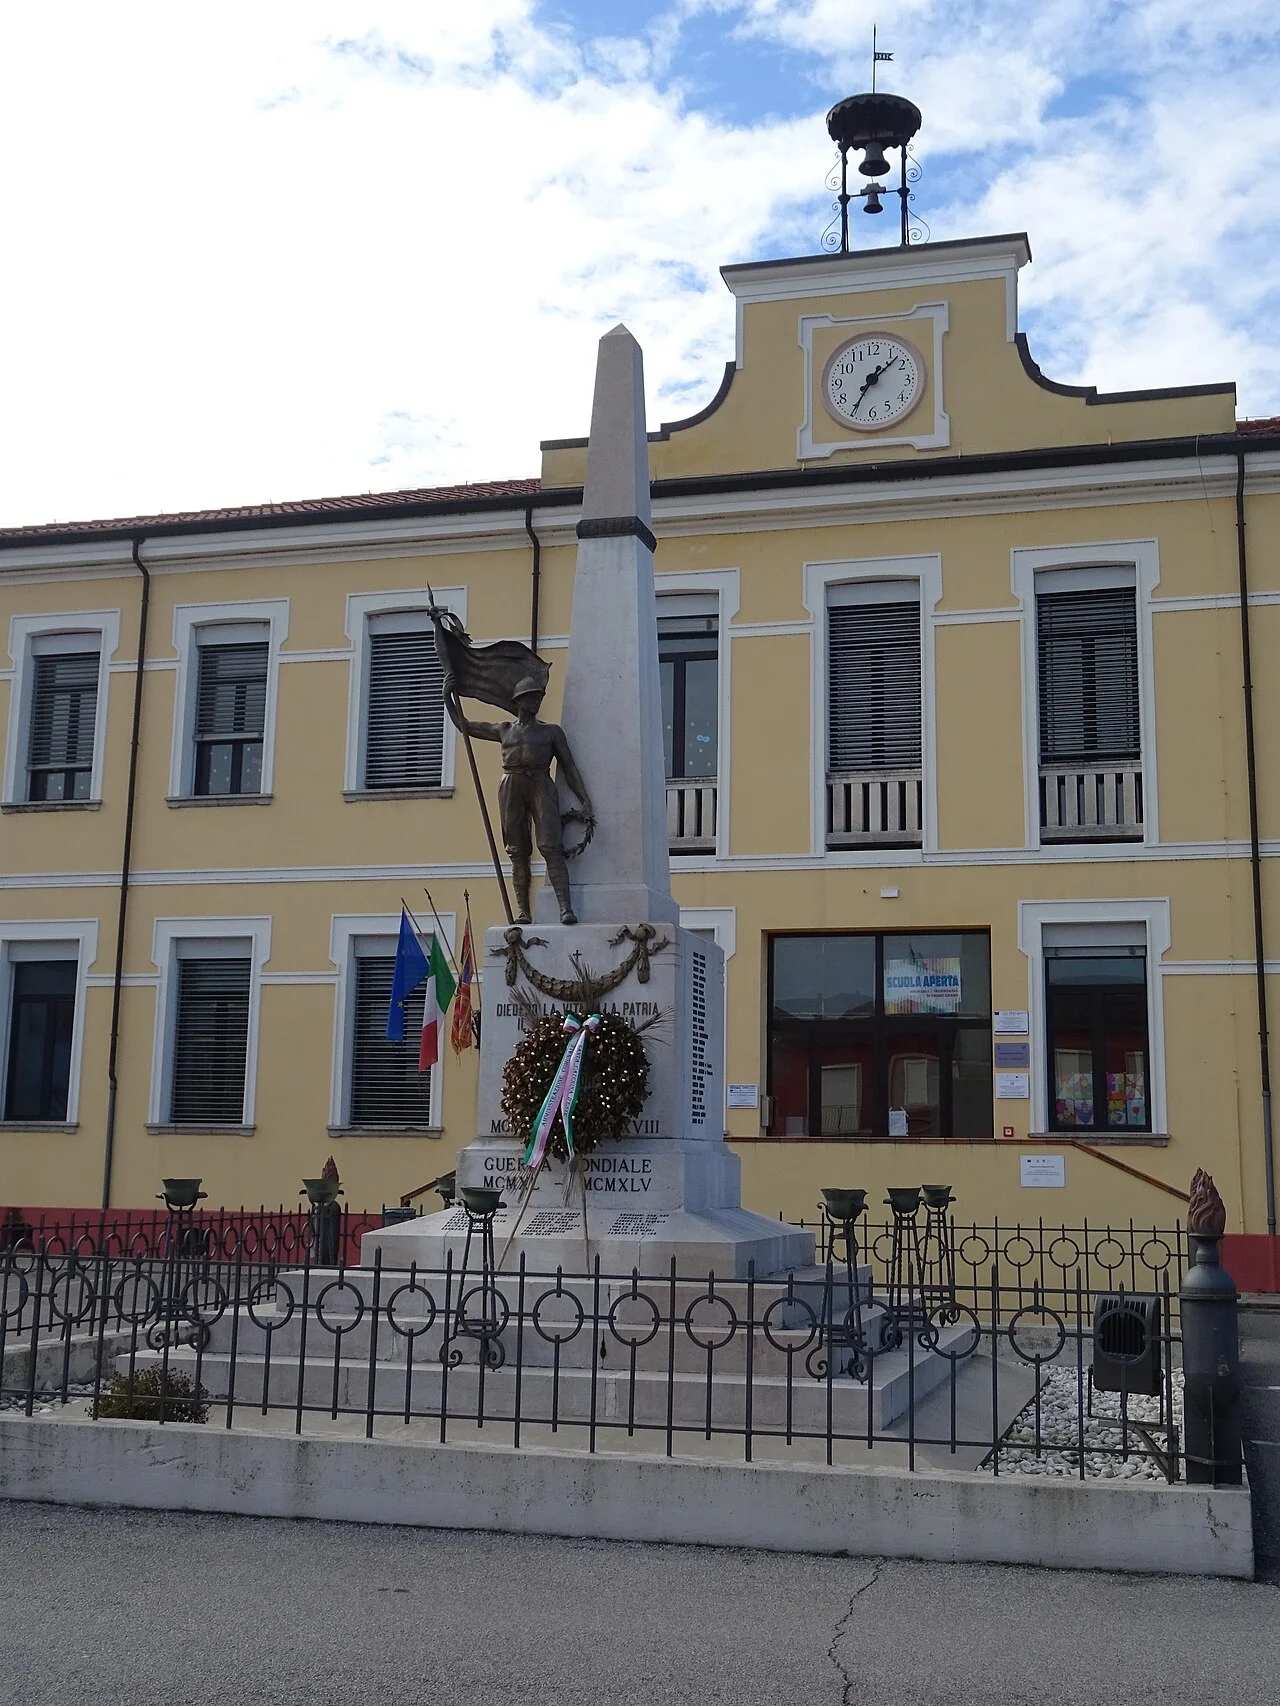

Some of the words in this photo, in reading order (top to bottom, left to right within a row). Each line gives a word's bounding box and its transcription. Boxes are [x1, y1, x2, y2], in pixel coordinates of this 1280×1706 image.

[852, 351, 863, 362] 11
[867, 345, 880, 356] 12
[888, 348, 893, 359] 1
[841, 363, 854, 375] 10
[899, 359, 906, 371] 2
[834, 378, 843, 391] 9
[904, 374, 911, 387] 3
[839, 393, 847, 404] 8
[897, 389, 905, 402] 4
[869, 406, 877, 418] 6
[884, 401, 891, 412] 5
[886, 976, 921, 988] SCUOLA
[923, 975, 959, 987] APERTA
[623, 1002, 658, 1016] PATRIA
[484, 1156, 552, 1172] GUERA
[582, 1158, 652, 1173] ONDIALE
[584, 1177, 652, 1192] MCMXLV
